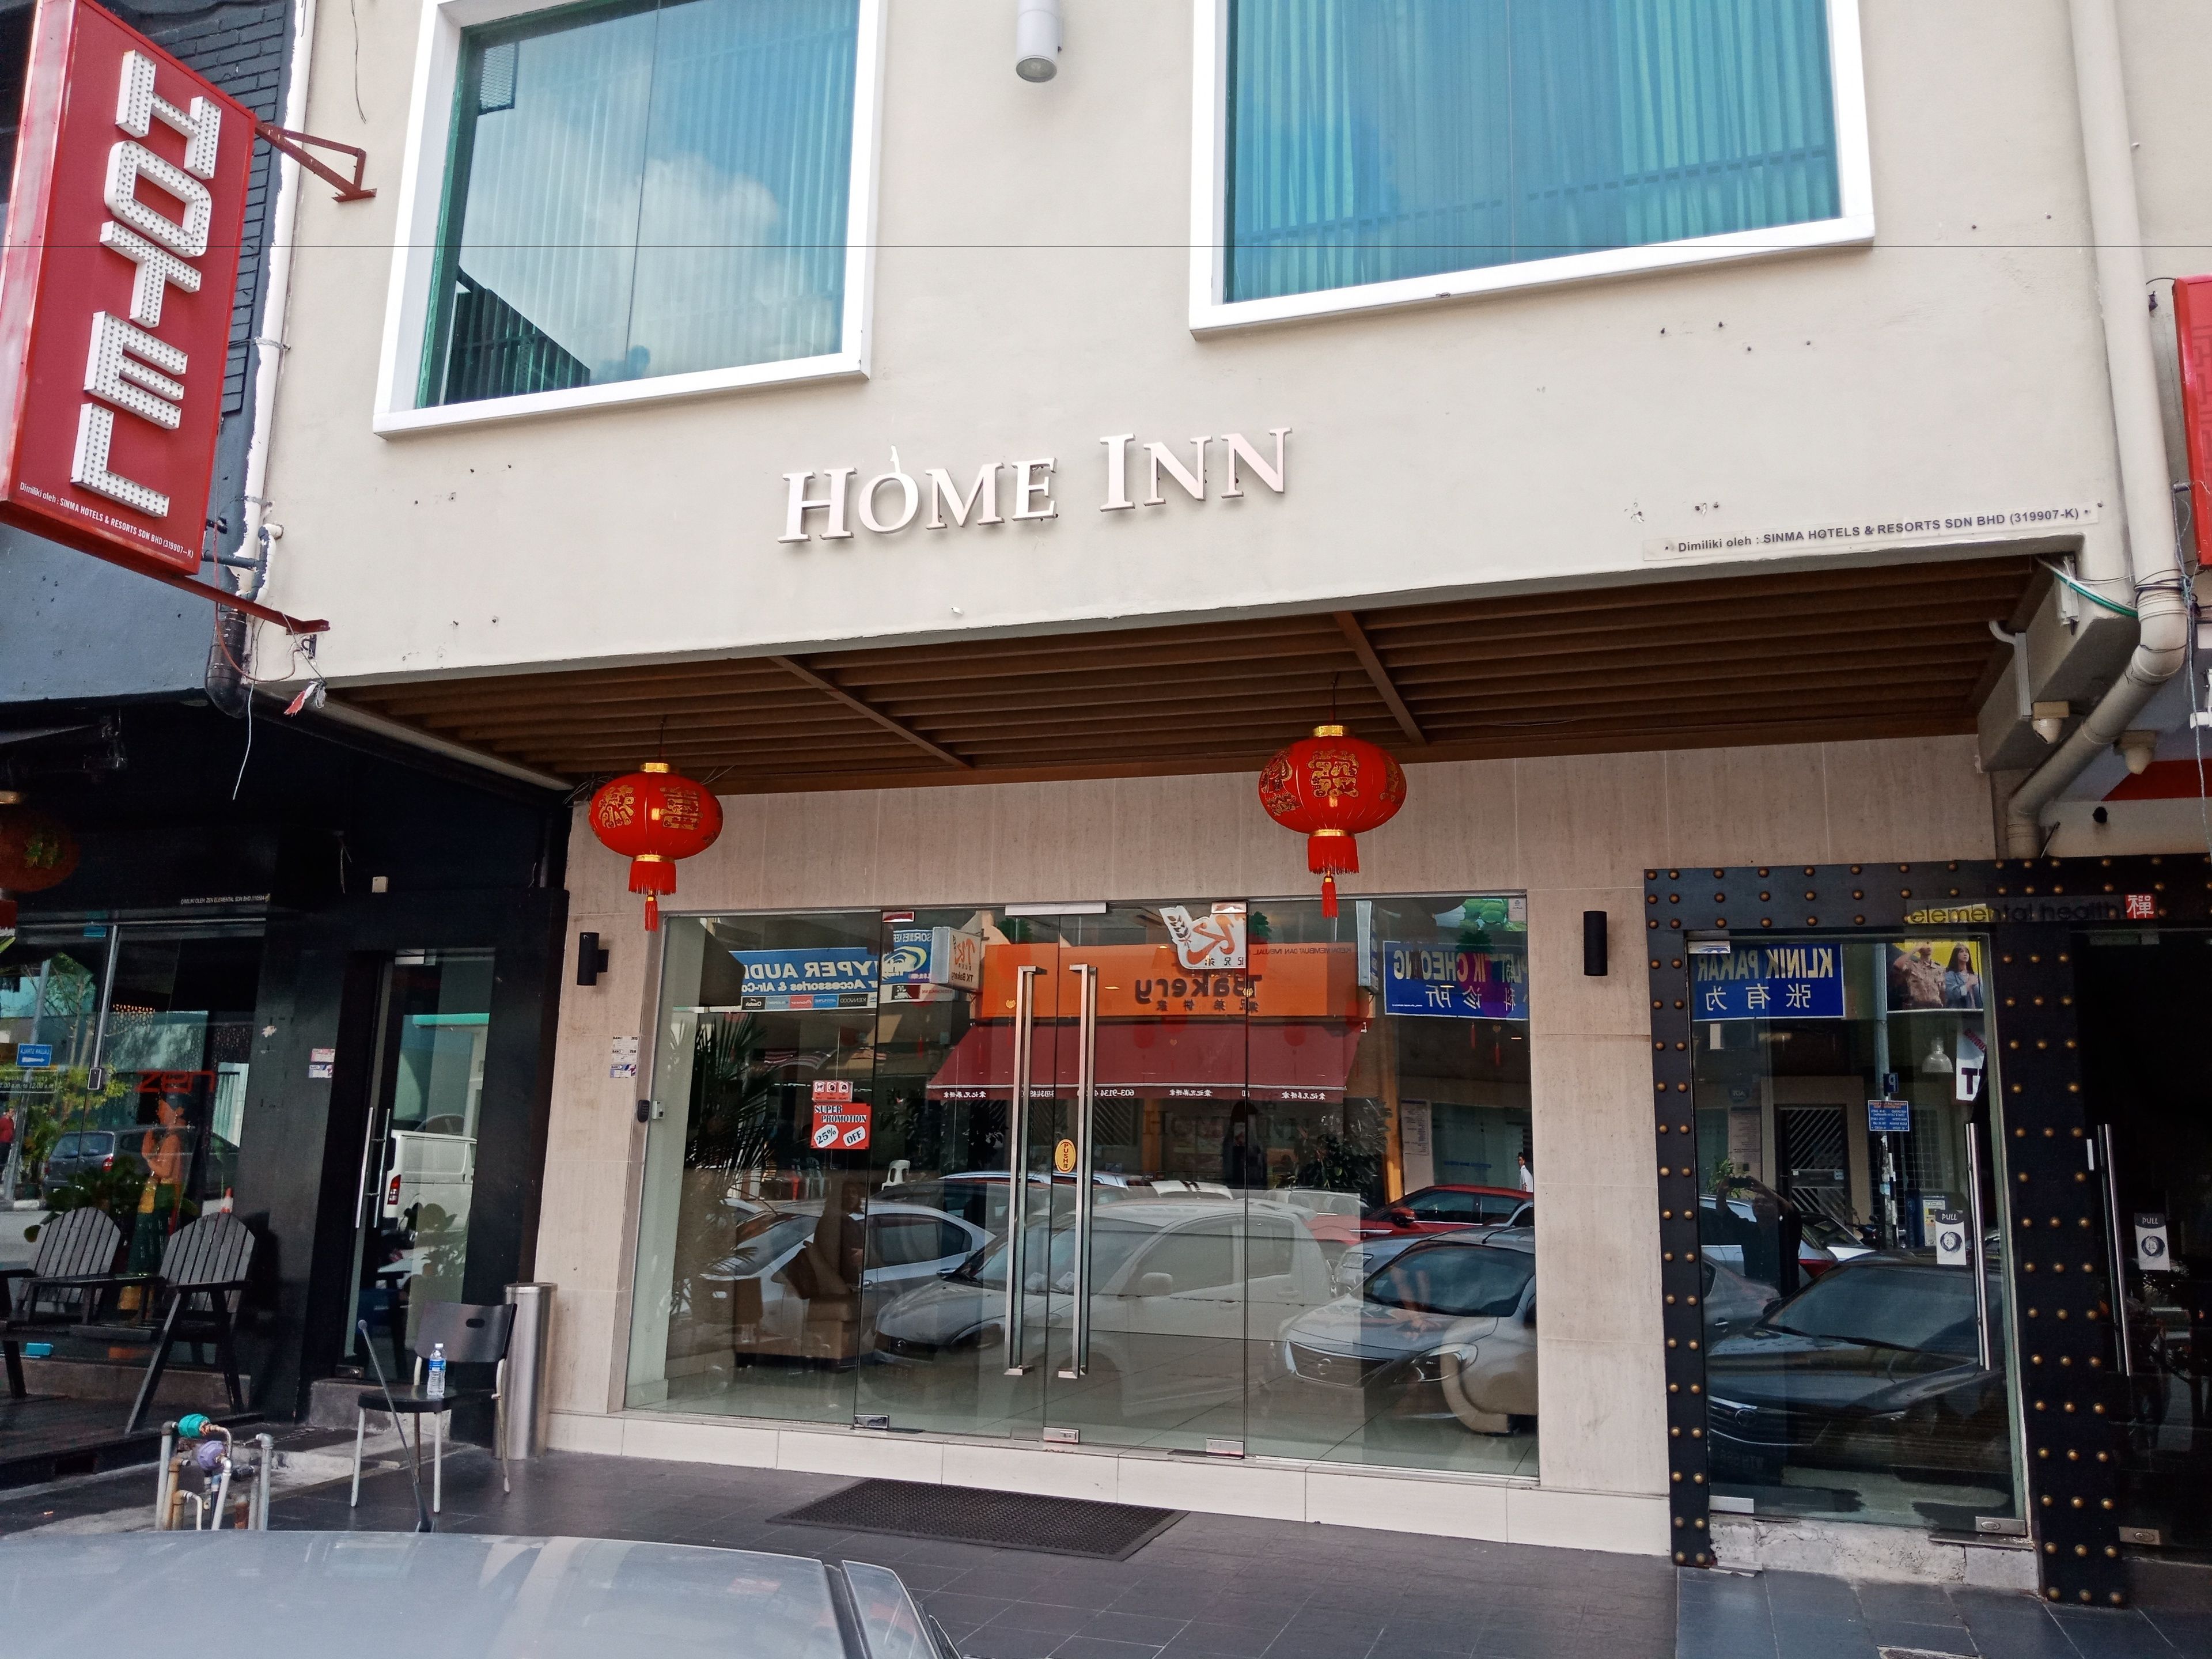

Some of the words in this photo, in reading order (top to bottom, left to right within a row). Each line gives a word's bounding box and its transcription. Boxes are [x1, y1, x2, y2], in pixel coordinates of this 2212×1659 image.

[70, 49, 221, 517] HOTEL
[778, 457, 1058, 543] HOME
[1099, 427, 1293, 512] INN
[20, 482, 42, 498] Dimiliki
[43, 491, 56, 503] oleh
[59, 498, 79, 512] SINMA
[79, 505, 104, 522] HOTELS
[104, 515, 109, 524] &
[111, 518, 138, 536] RESORTS
[138, 529, 150, 540] SDN
[150, 533, 162, 545] BHD
[1677, 536, 1724, 553] Dimiliki
[1726, 535, 1752, 548] oleh
[1762, 531, 1804, 544] SINMA
[1808, 526, 1861, 540] HOTELS
[1863, 525, 1874, 536] &
[1877, 520, 1941, 535] RESORTS
[1944, 517, 1973, 529] SDN
[1976, 514, 2006, 526] BHD
[2009, 507, 2080, 526] (319907-K)
[1910, 902, 2033, 924] elemental
[2039, 901, 2121, 921] health
[134, 1069, 217, 1093] zen
[815, 1105, 843, 1113] SUPER
[821, 1115, 867, 1123] PROMOTION
[816, 1127, 837, 1145] 25%
[846, 1130, 863, 1144] OFF
